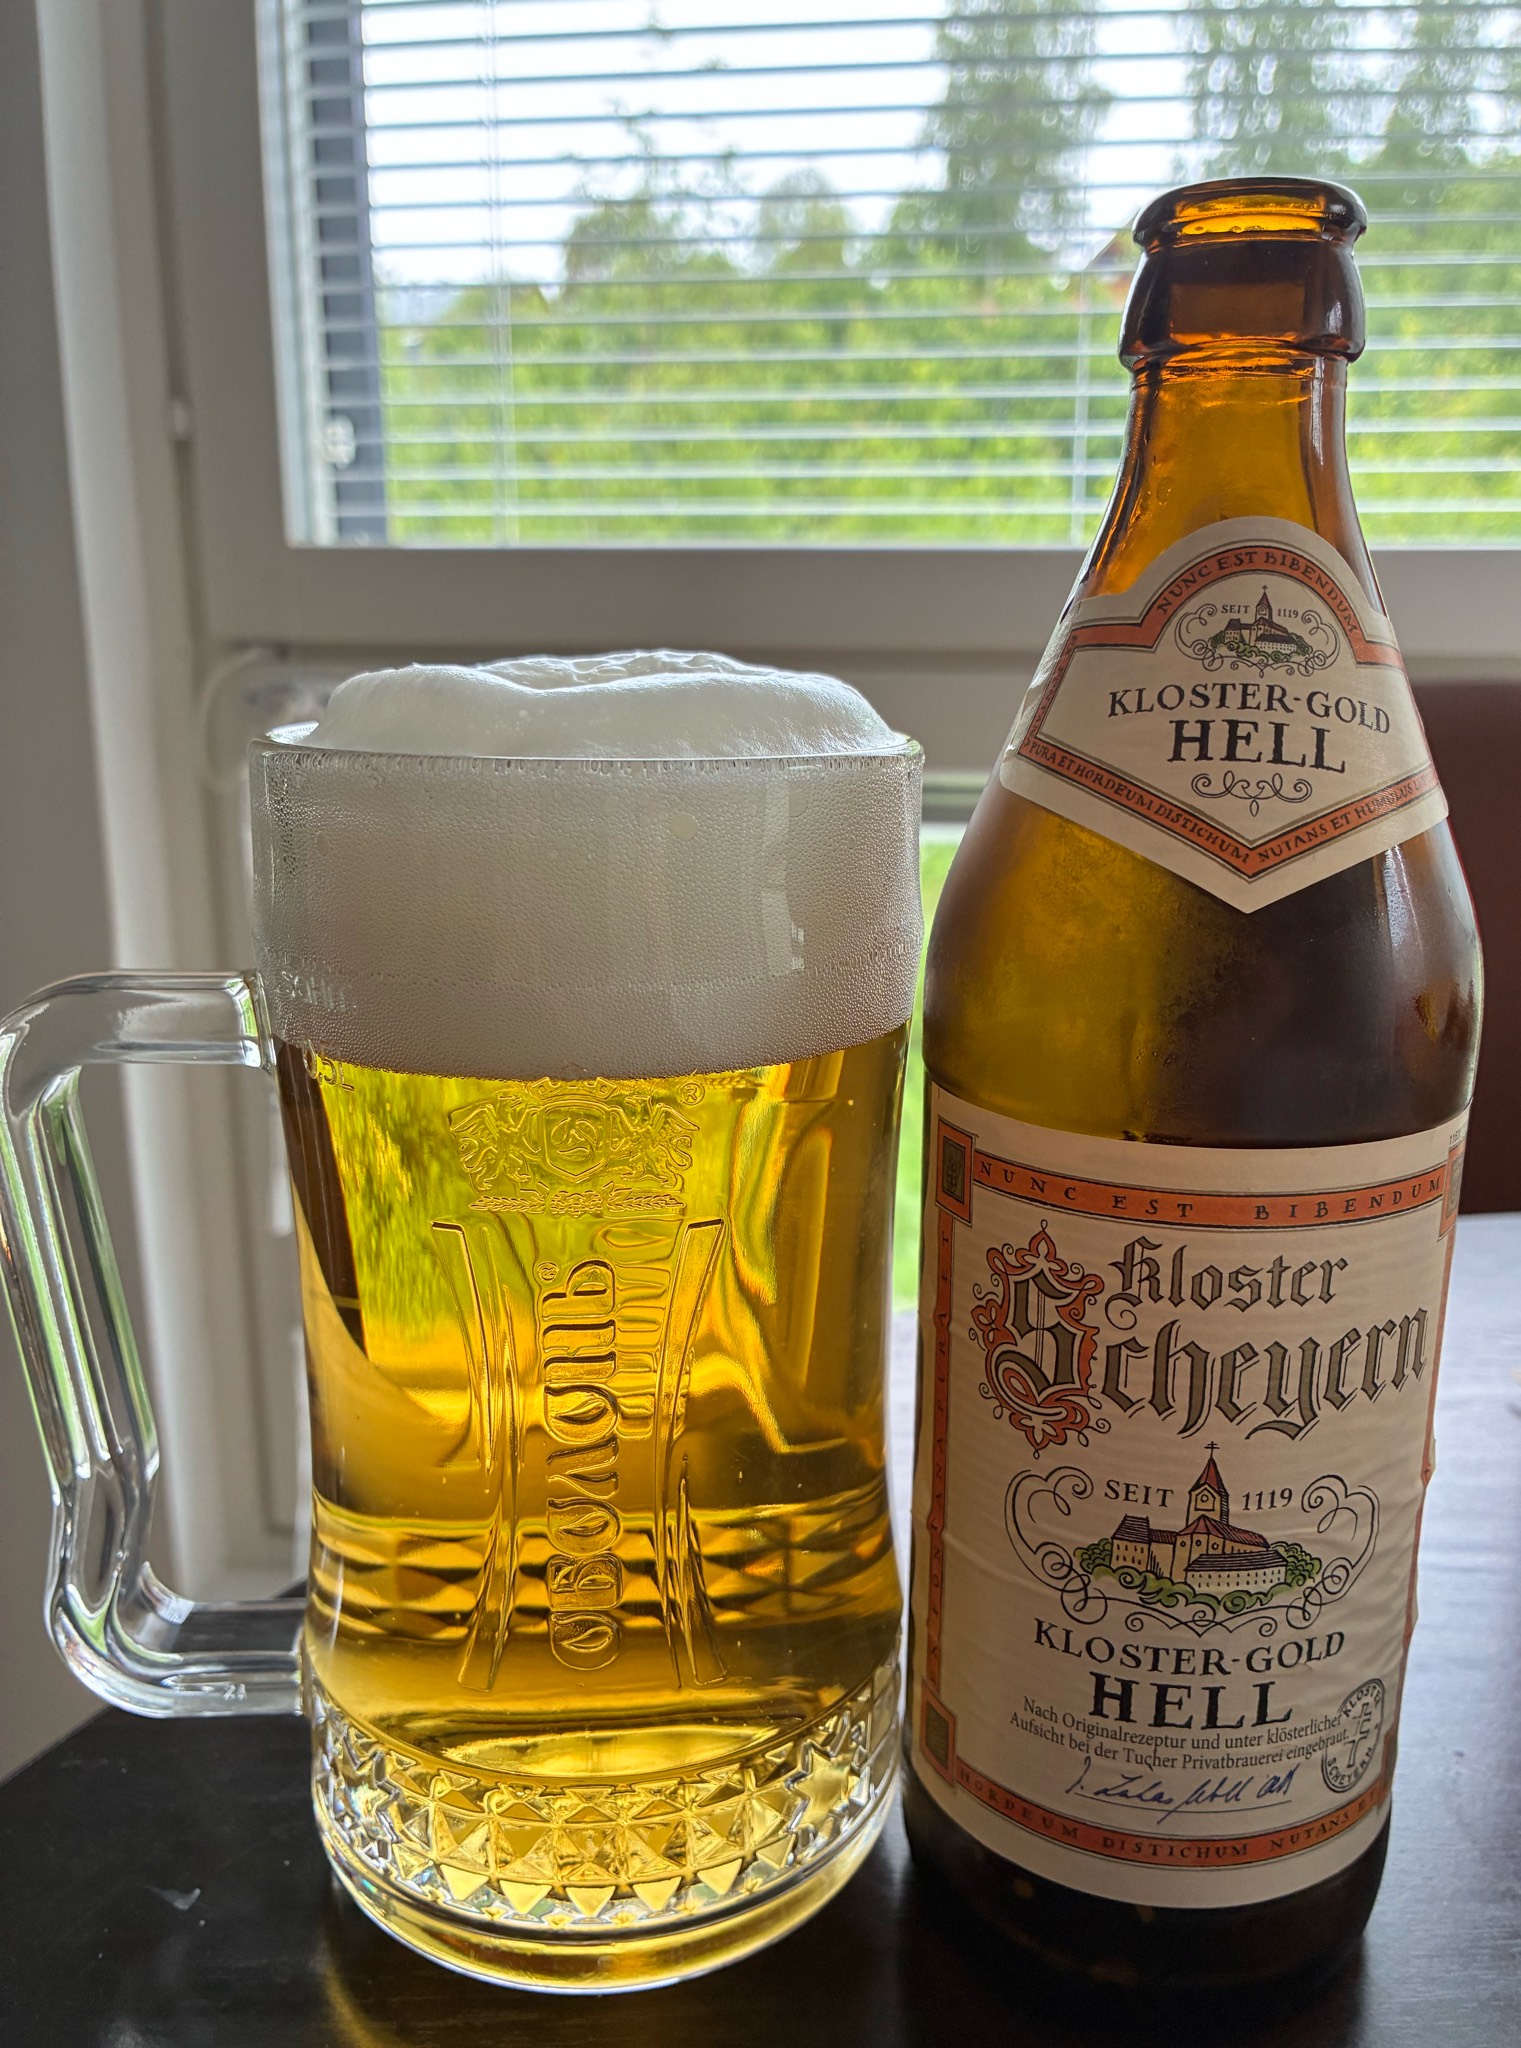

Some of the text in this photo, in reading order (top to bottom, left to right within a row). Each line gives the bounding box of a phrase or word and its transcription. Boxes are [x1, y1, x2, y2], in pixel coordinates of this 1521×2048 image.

[1156, 551, 1358, 634] NUNC EST BIBENDUM
[1221, 604, 1299, 619] SEIT 1119
[1108, 682, 1390, 735] KLOSTER-GOLD
[1167, 718, 1347, 774] HELL
[1030, 741, 1250, 864] PURA ET HORDEUM DISTICHUM
[1257, 823, 1328, 862] NUTANS
[1332, 812, 1351, 831] ET
[979, 1161, 1441, 1220] NUNC EST BIBENDUM
[1104, 1236, 1349, 1330] Kloster
[985, 1252, 1429, 1441] Scheyern
[1103, 1479, 1292, 1511] SEIT 1119
[1033, 1617, 1345, 1677] KLOSTER-GOLD
[1023, 1696, 1343, 1752] Nach Originalrezeptur und unter klösterlicher
[1088, 1671, 1293, 1731] HELL
[1009, 1711, 1349, 1770] Aufsicht bei der Tucher Privatbrauerei eingebraut.
[960, 1768, 1081, 1840] HORDEUM
[1102, 1835, 1249, 1860] DISTICHUM
[1269, 1811, 1350, 1853] NUTANS
